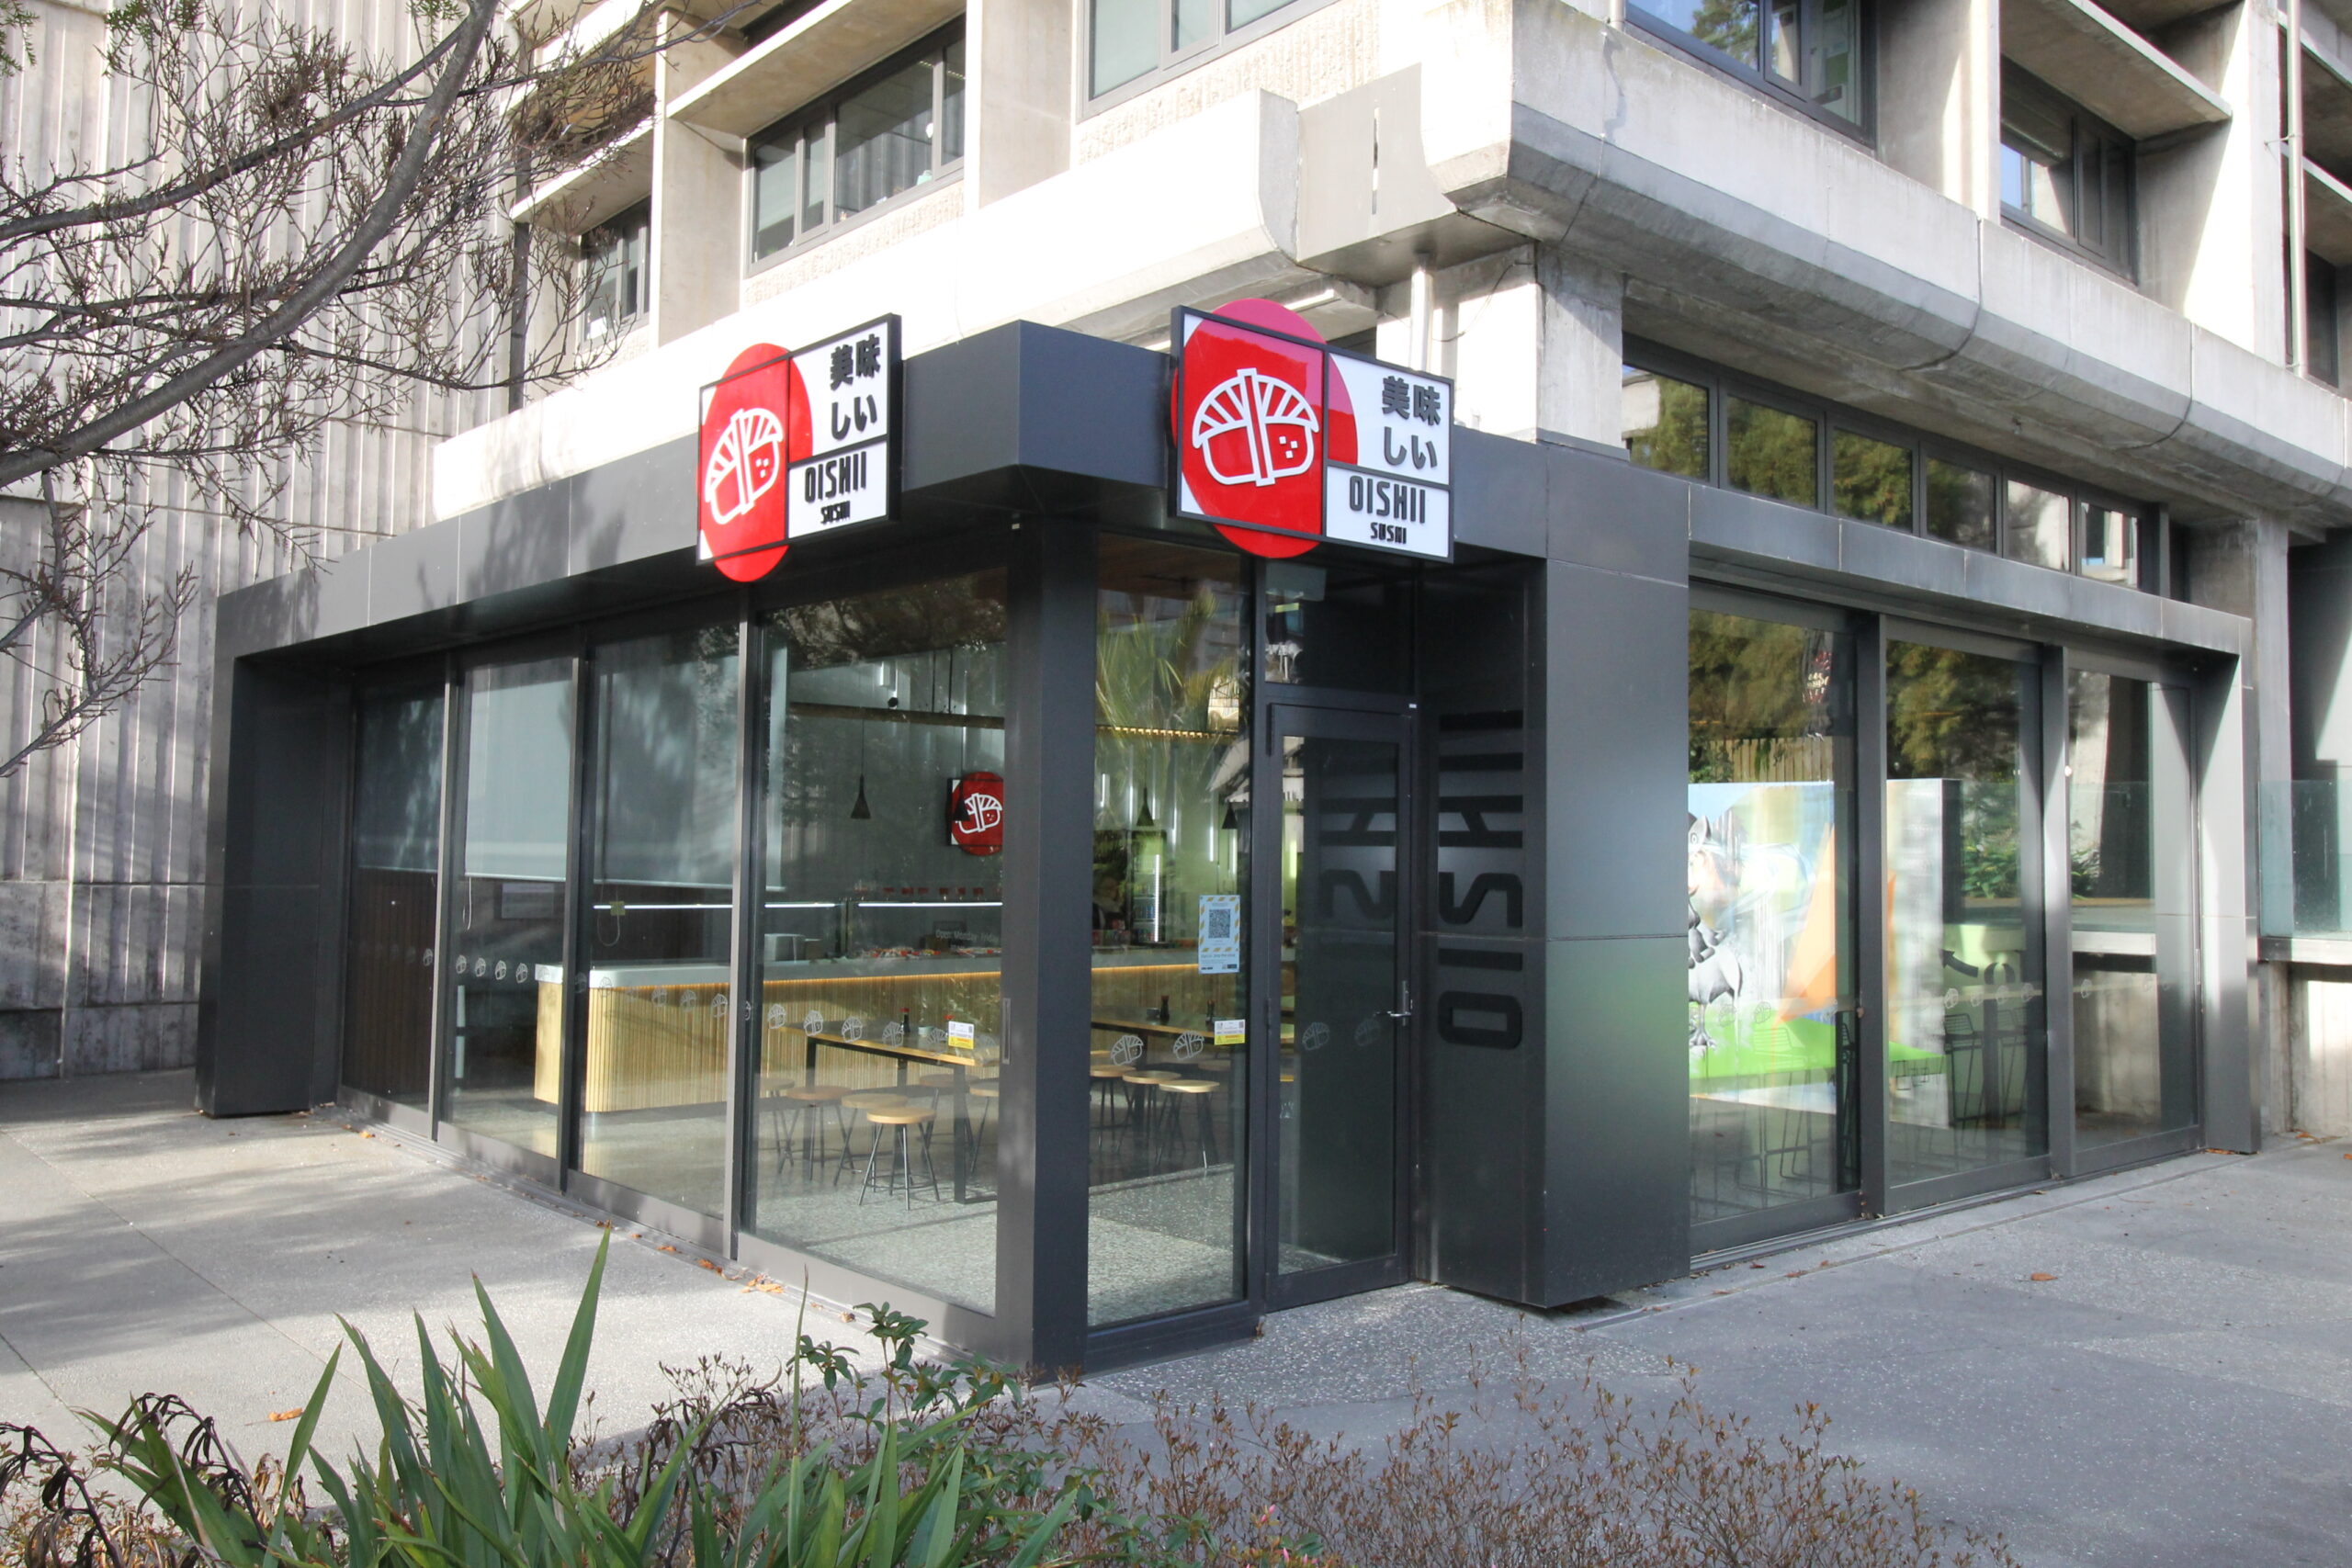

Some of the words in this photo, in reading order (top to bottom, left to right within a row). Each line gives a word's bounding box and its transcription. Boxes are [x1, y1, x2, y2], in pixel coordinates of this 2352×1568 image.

[830, 333, 881, 391] 美味
[831, 394, 877, 441] しい
[1381, 375, 1442, 426] 美味
[1383, 426, 1438, 470] しい
[804, 451, 867, 504] OISHII
[1349, 475, 1426, 524] OISHII
[820, 501, 851, 525] SUSHI
[1370, 522, 1407, 545] SUSHI
[1437, 709, 1524, 1050] OISHII
